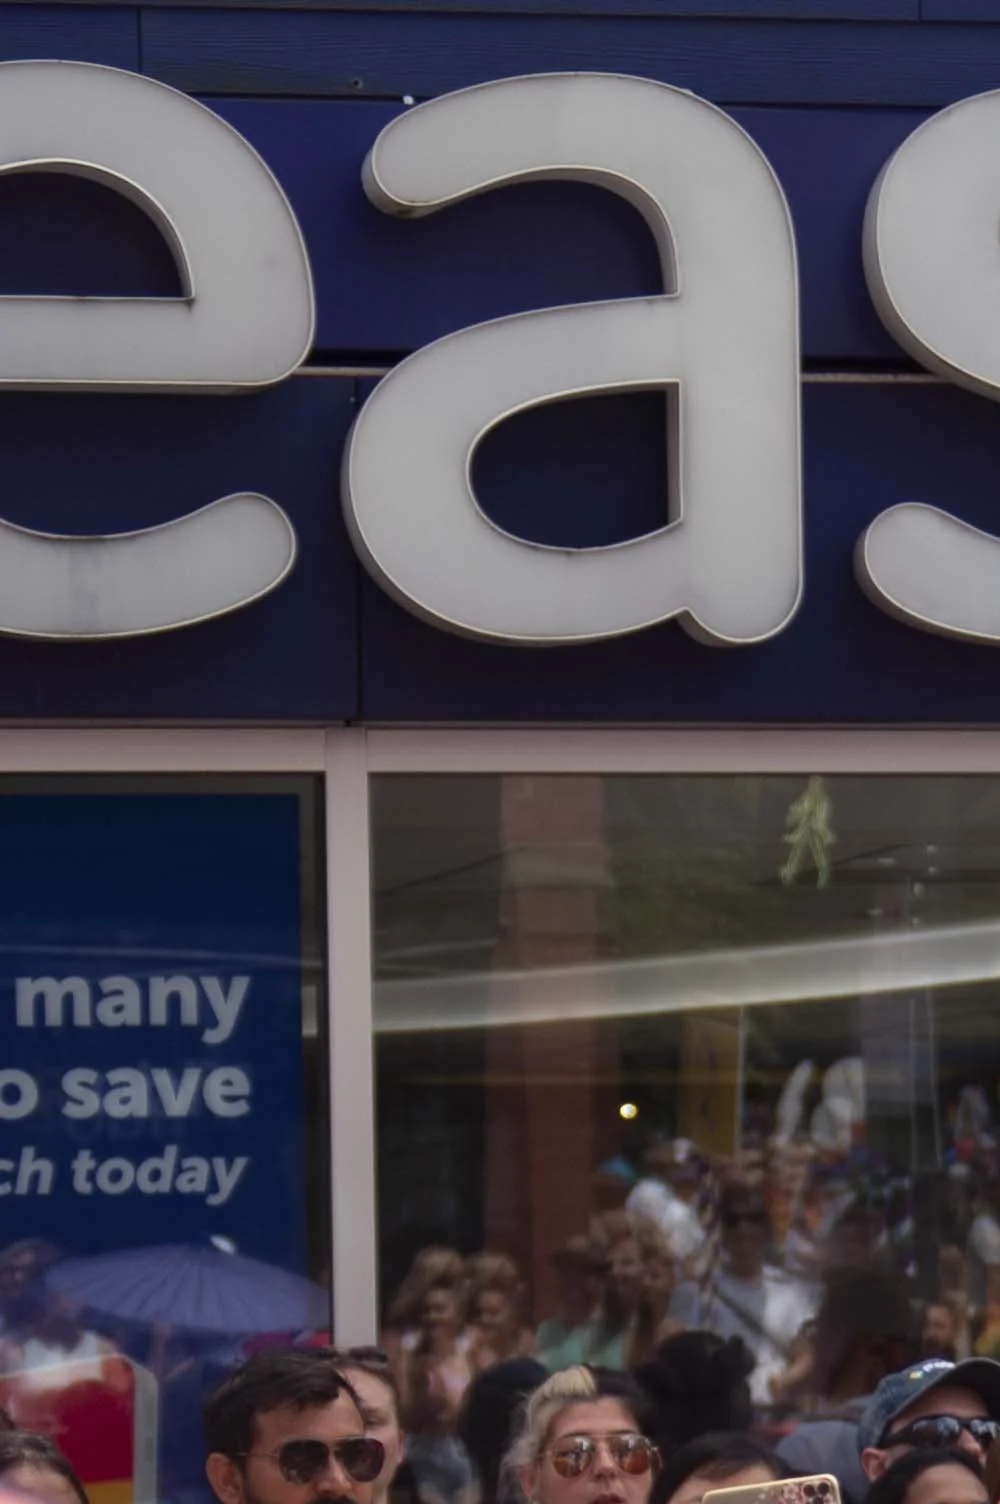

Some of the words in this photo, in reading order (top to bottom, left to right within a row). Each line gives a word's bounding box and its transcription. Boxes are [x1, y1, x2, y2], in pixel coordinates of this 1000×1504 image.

[15, 975, 250, 1044] many
[61, 1066, 251, 1119] save
[71, 1145, 249, 1205] today
